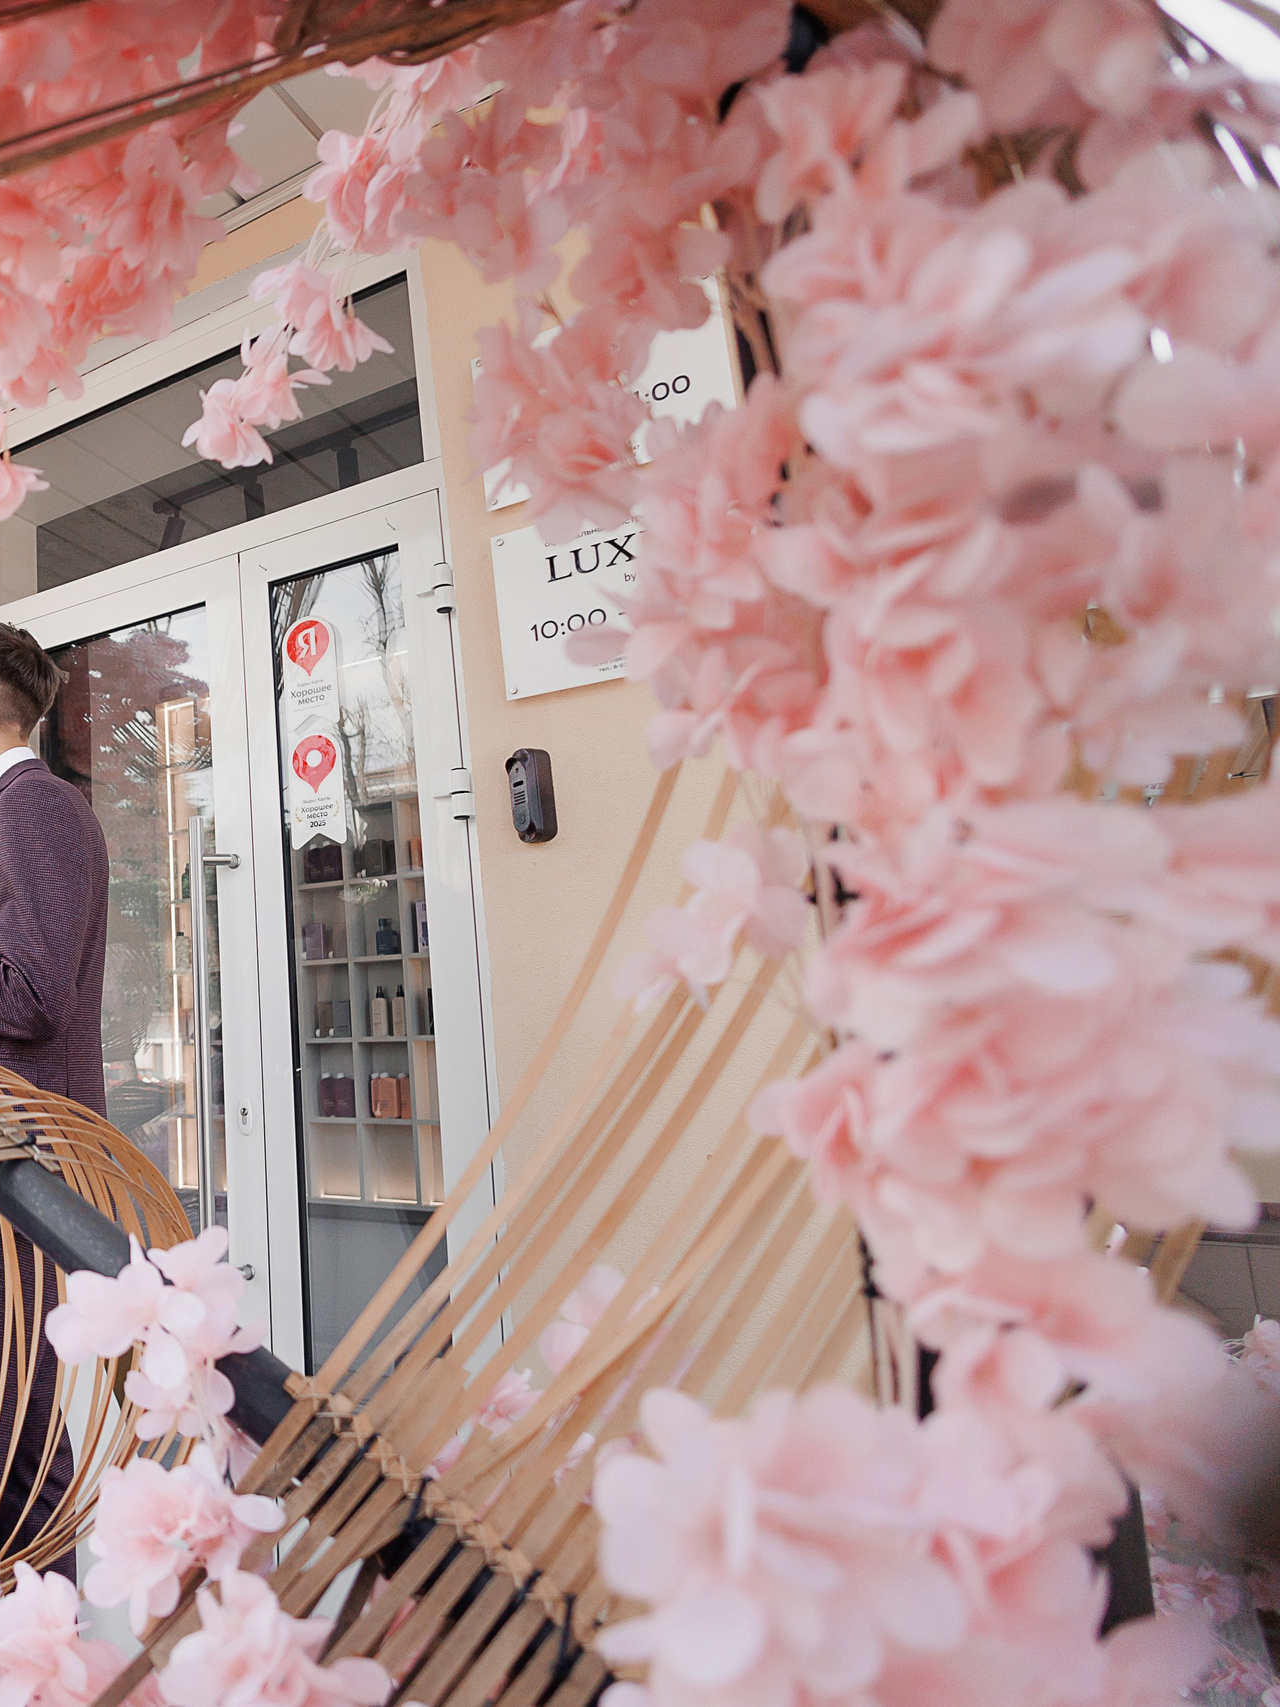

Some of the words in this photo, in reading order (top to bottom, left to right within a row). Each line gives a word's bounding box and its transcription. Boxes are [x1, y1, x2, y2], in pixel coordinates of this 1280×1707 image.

[545, 530, 646, 583] LUX
[623, 572, 638, 582] by
[530, 608, 607, 642] 10:00
[297, 627, 317, 659] Я
[290, 684, 332, 699] Хорошее
[298, 694, 326, 705] место
[300, 804, 334, 813] Хорошее
[306, 811, 329, 819] место
[309, 819, 327, 828] 2025
